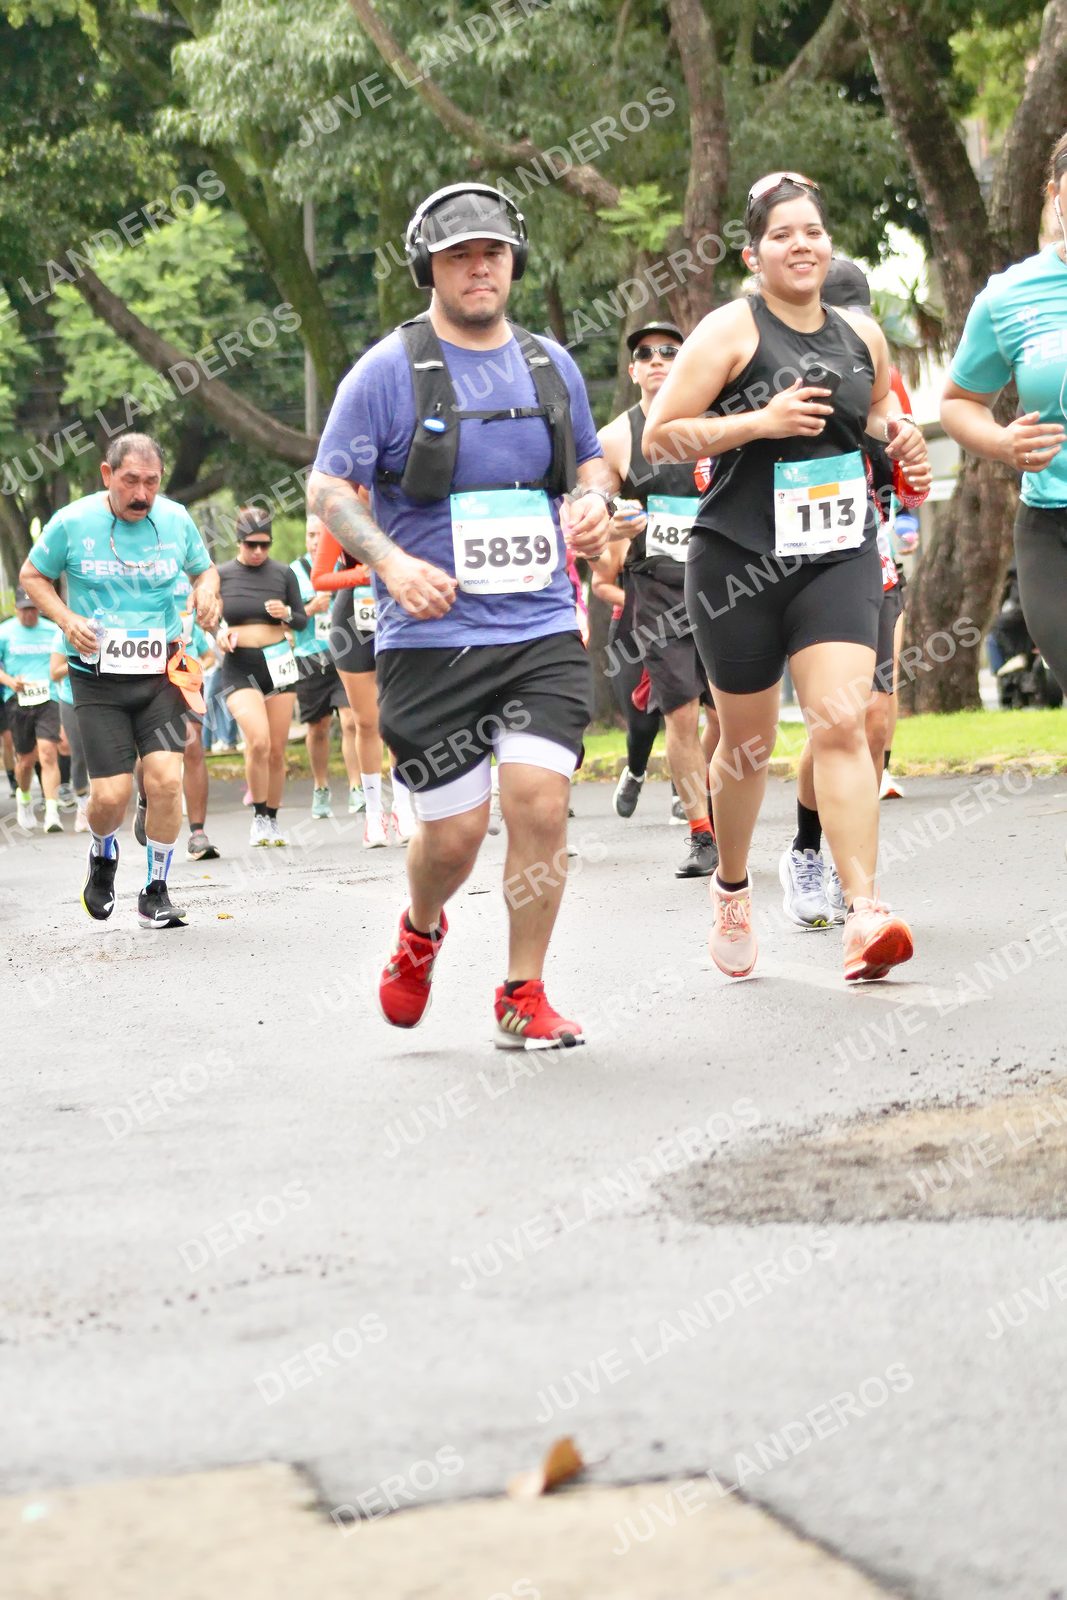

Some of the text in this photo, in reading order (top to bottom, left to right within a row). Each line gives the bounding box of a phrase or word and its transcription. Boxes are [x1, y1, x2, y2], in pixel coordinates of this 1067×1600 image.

[797, 498, 855, 532] 113
[464, 535, 551, 570] 5839
[81, 558, 179, 576] PERDURA
[106, 640, 162, 658] 4060
